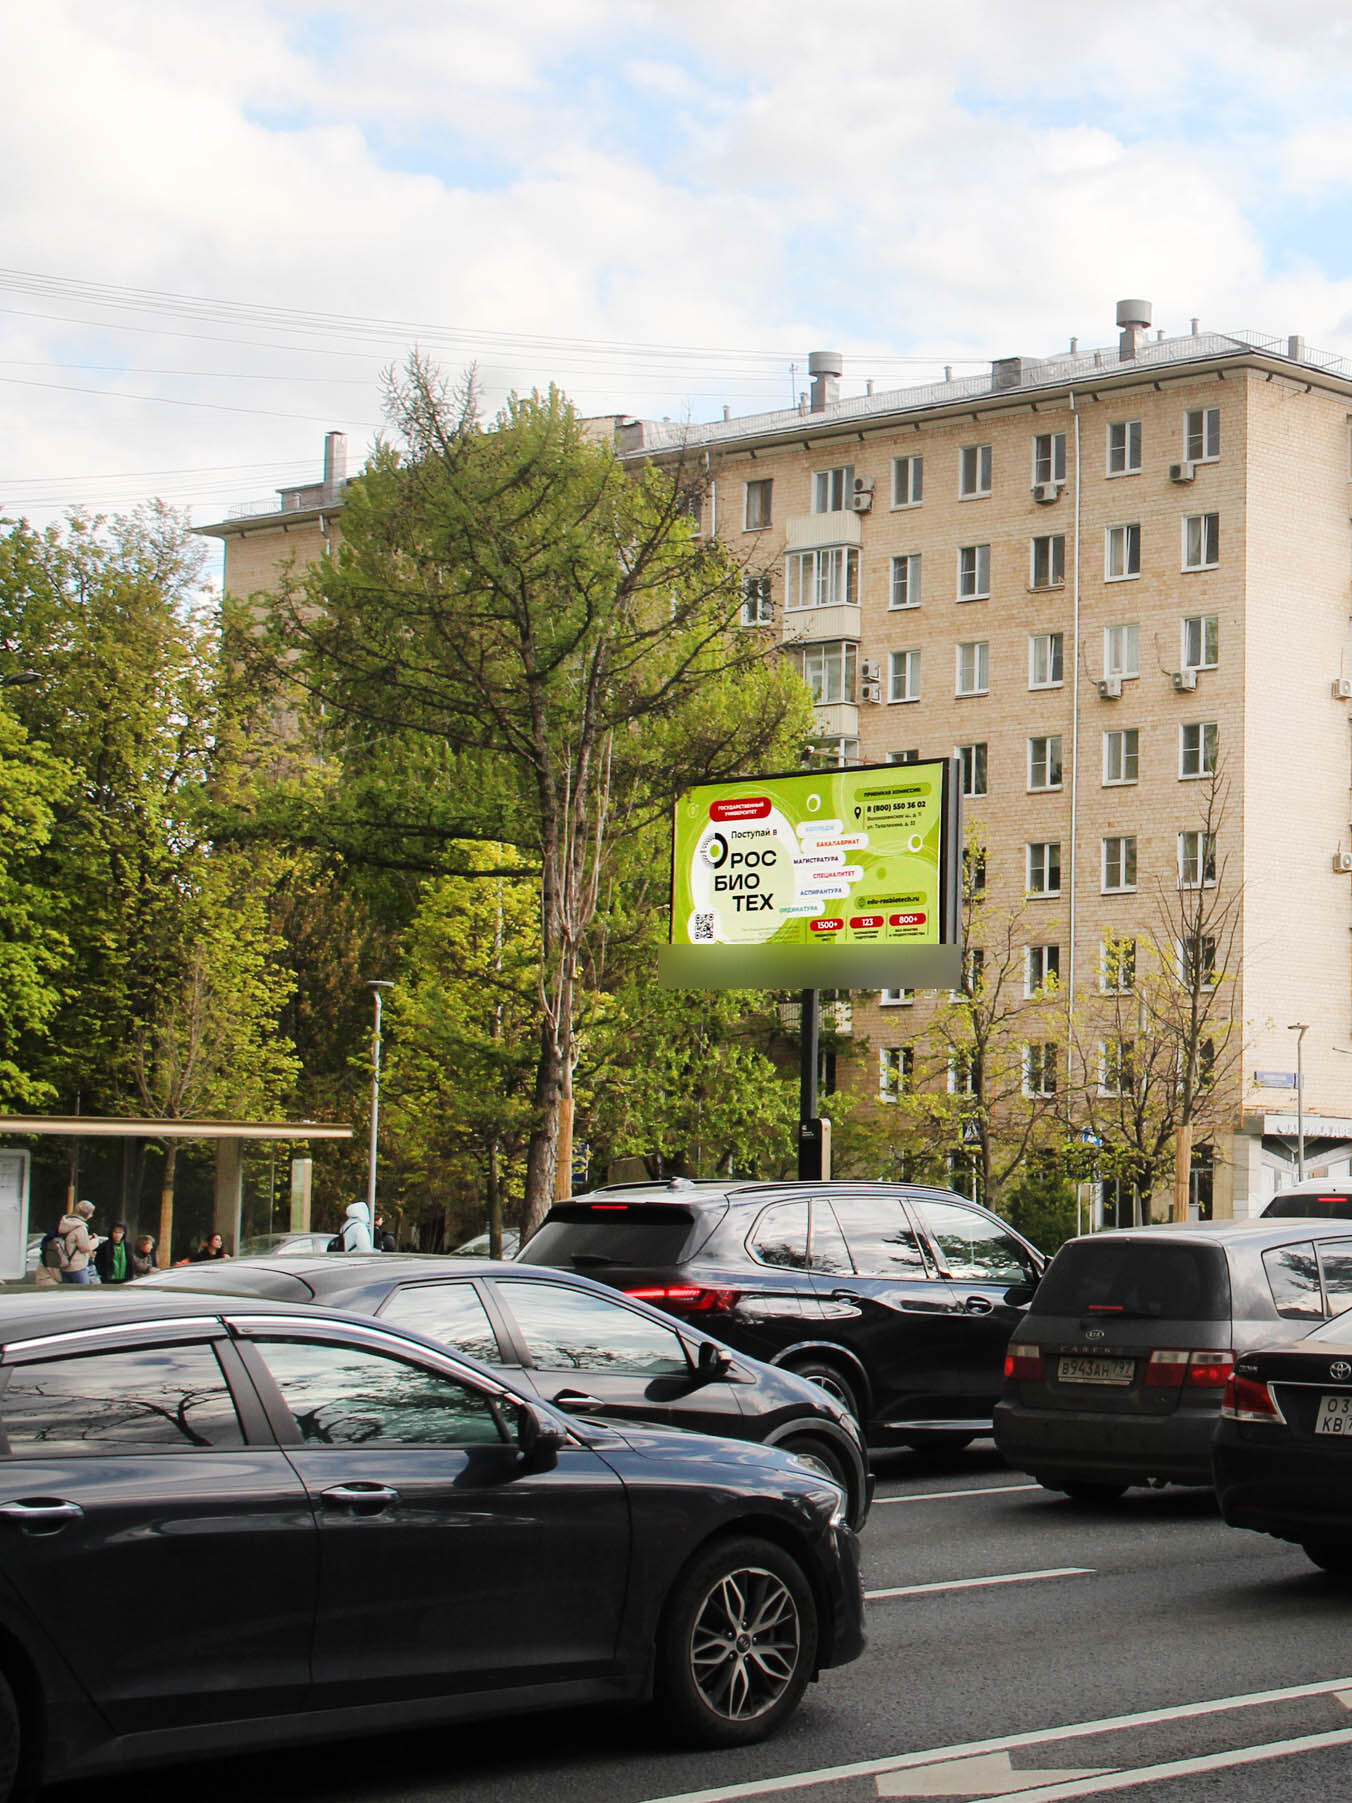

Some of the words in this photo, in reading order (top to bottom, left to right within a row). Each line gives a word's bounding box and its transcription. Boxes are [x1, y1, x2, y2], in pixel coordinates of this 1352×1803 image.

[873, 804, 892, 813] (800)
[893, 802, 906, 810] 550
[917, 800, 926, 808] 02
[732, 828, 770, 839] Поступай
[816, 839, 860, 848] БАКАЛАВРИАТ
[731, 850, 776, 868] РОС
[794, 856, 839, 864] МАГИСТРАТУРА
[813, 870, 855, 879] СПЕЦИАЛИТЕТ
[714, 873, 760, 892] БИО
[800, 888, 842, 896] АСПИРАНТУРА
[732, 893, 774, 912] ТЕХ
[862, 918, 874, 926] 123
[898, 915, 918, 924] 800+
[817, 921, 838, 929] 1500+
[1321, 1417, 1343, 1433] КВ
